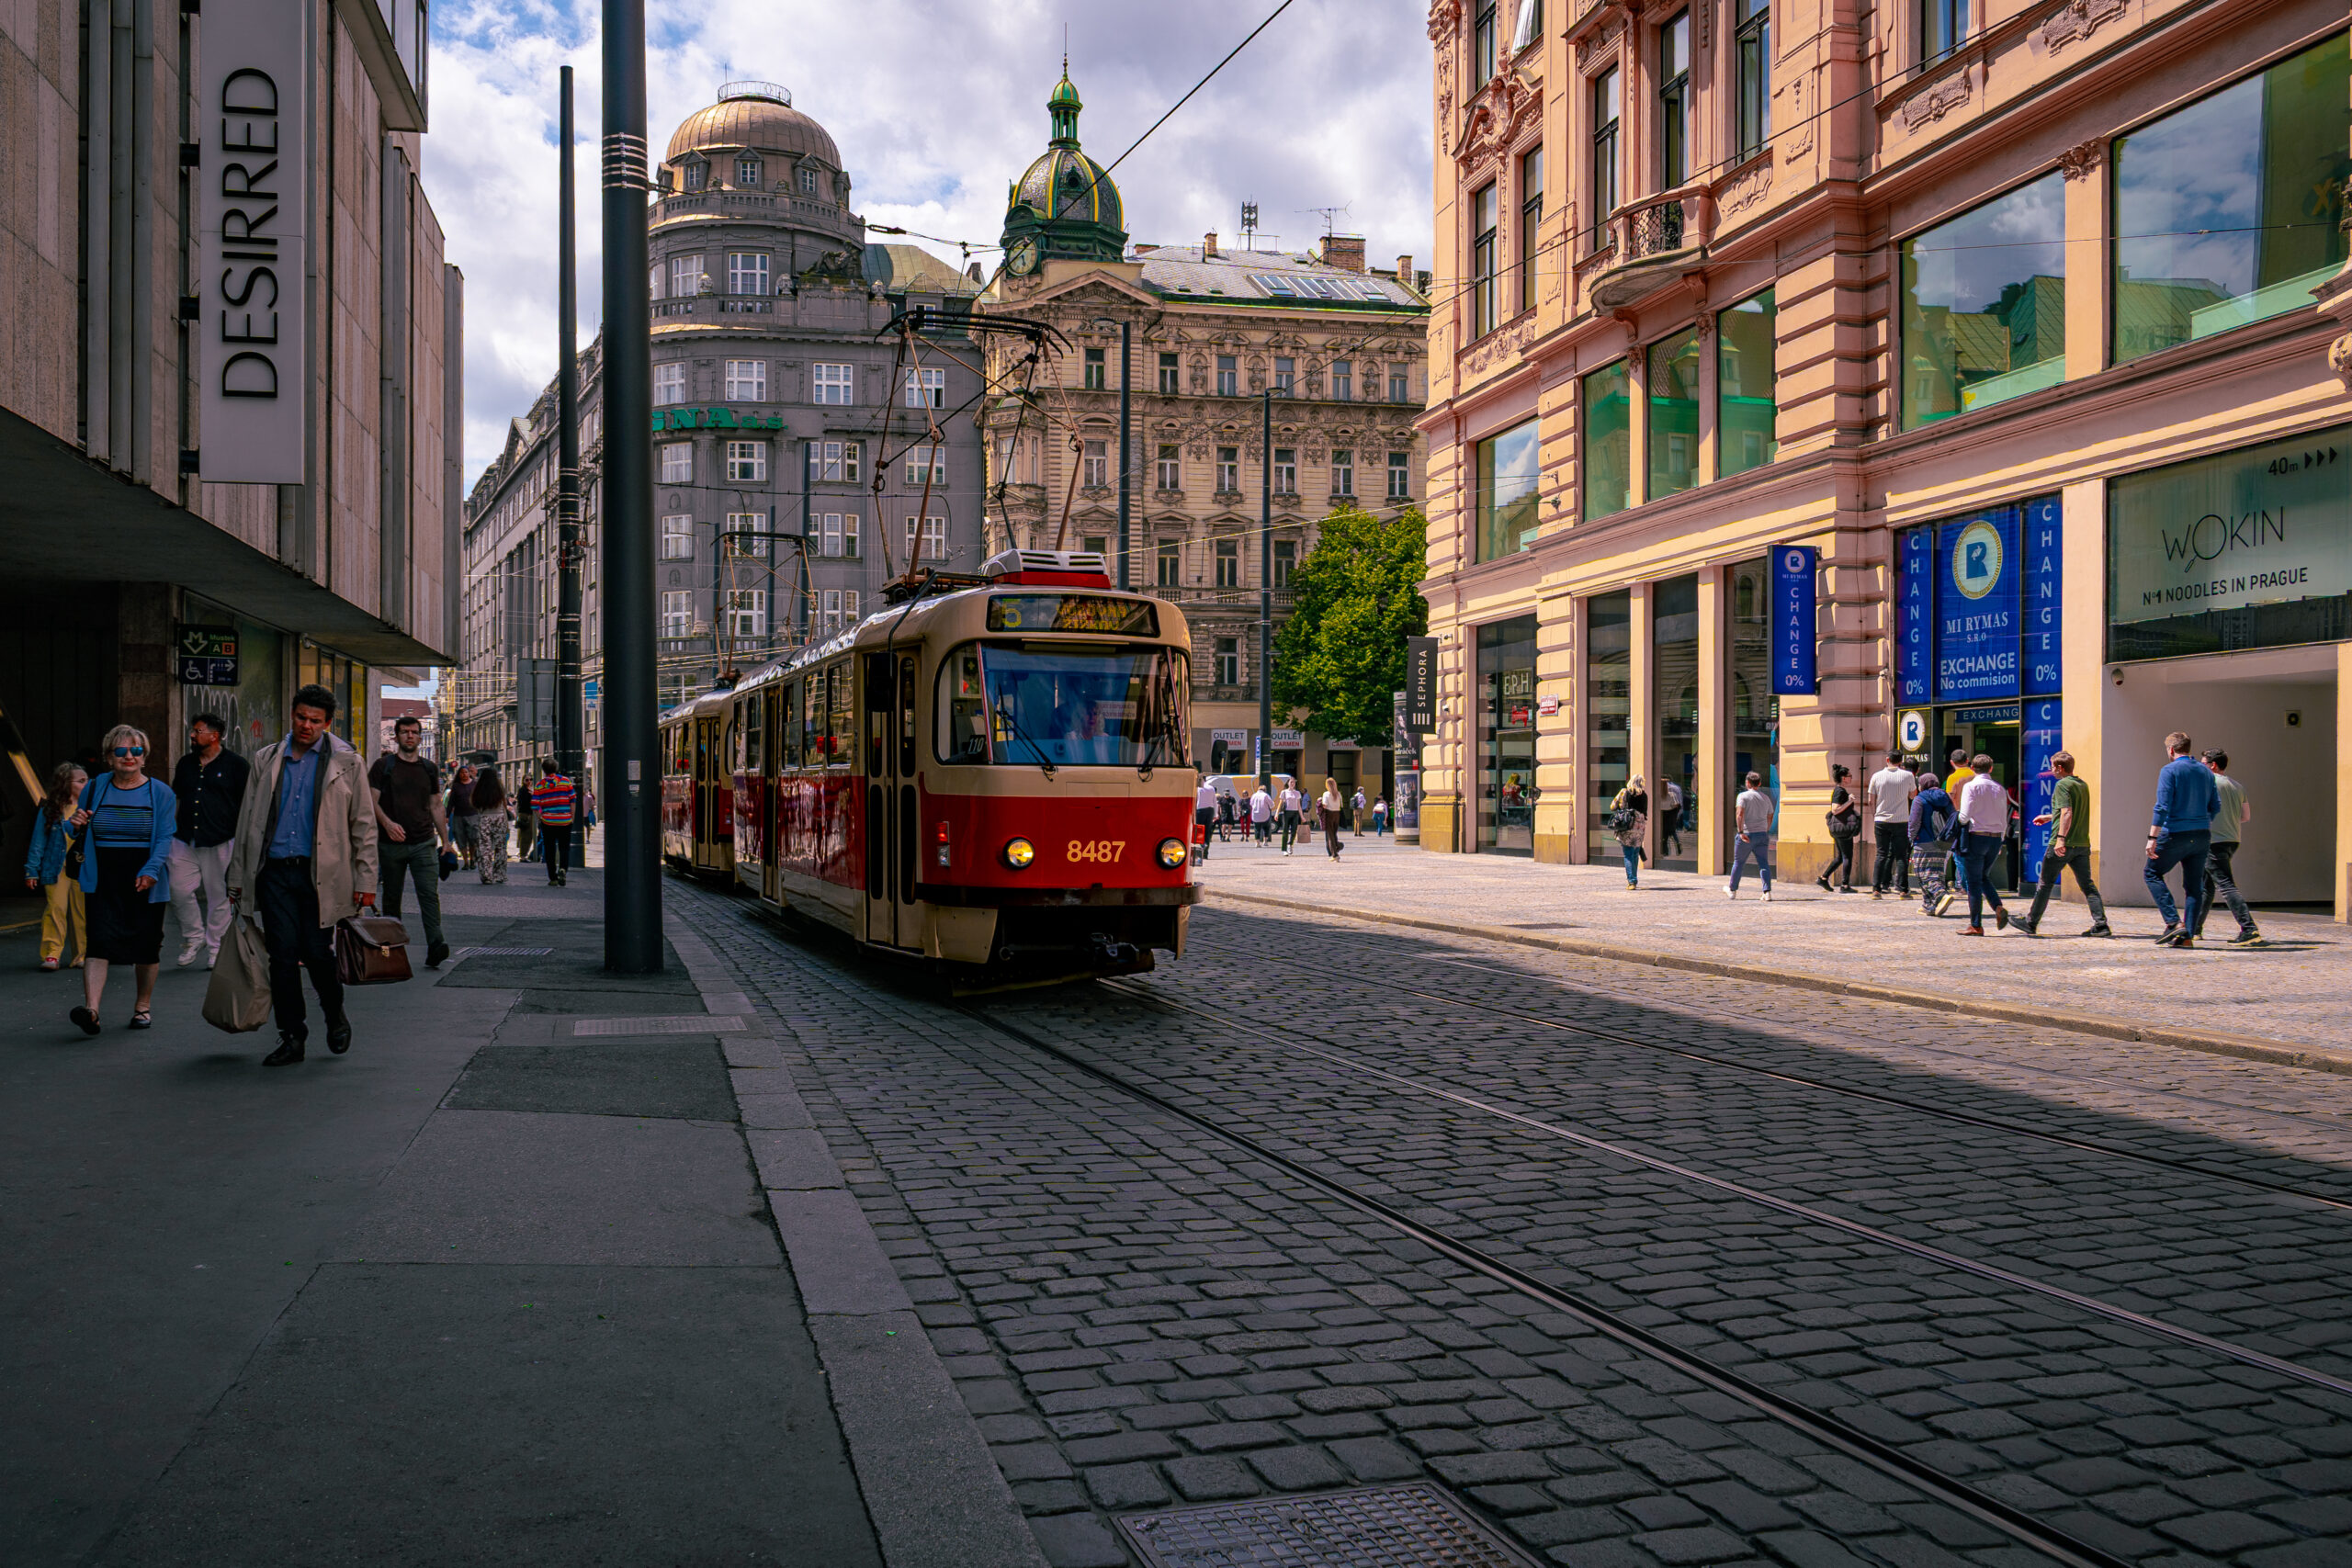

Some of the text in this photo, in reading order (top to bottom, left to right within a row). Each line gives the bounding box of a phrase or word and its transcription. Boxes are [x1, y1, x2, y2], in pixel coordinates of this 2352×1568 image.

[221, 67, 278, 398] DESIRRED
[2162, 506, 2283, 562] WOKIN
[2041, 504, 2052, 650] CHANGE
[2165, 580, 2227, 602] NOODLES
[2232, 577, 2245, 593] IN
[2250, 567, 2308, 590] PRAGUE
[1001, 598, 1022, 627] 5
[1910, 536, 1919, 667] CHANGE
[1790, 587, 1800, 669] CHANGE
[1946, 611, 2008, 634] MI RYMAS
[1940, 651, 2015, 676] EXCHANGE
[2035, 664, 2056, 682] 0%
[1418, 649, 1428, 707] SEPHORA
[1785, 674, 1804, 686] 0%
[1905, 679, 1924, 695] 0%
[1940, 671, 2015, 690] No commision
[967, 737, 985, 754] 110
[1067, 840, 1125, 863] 8487
